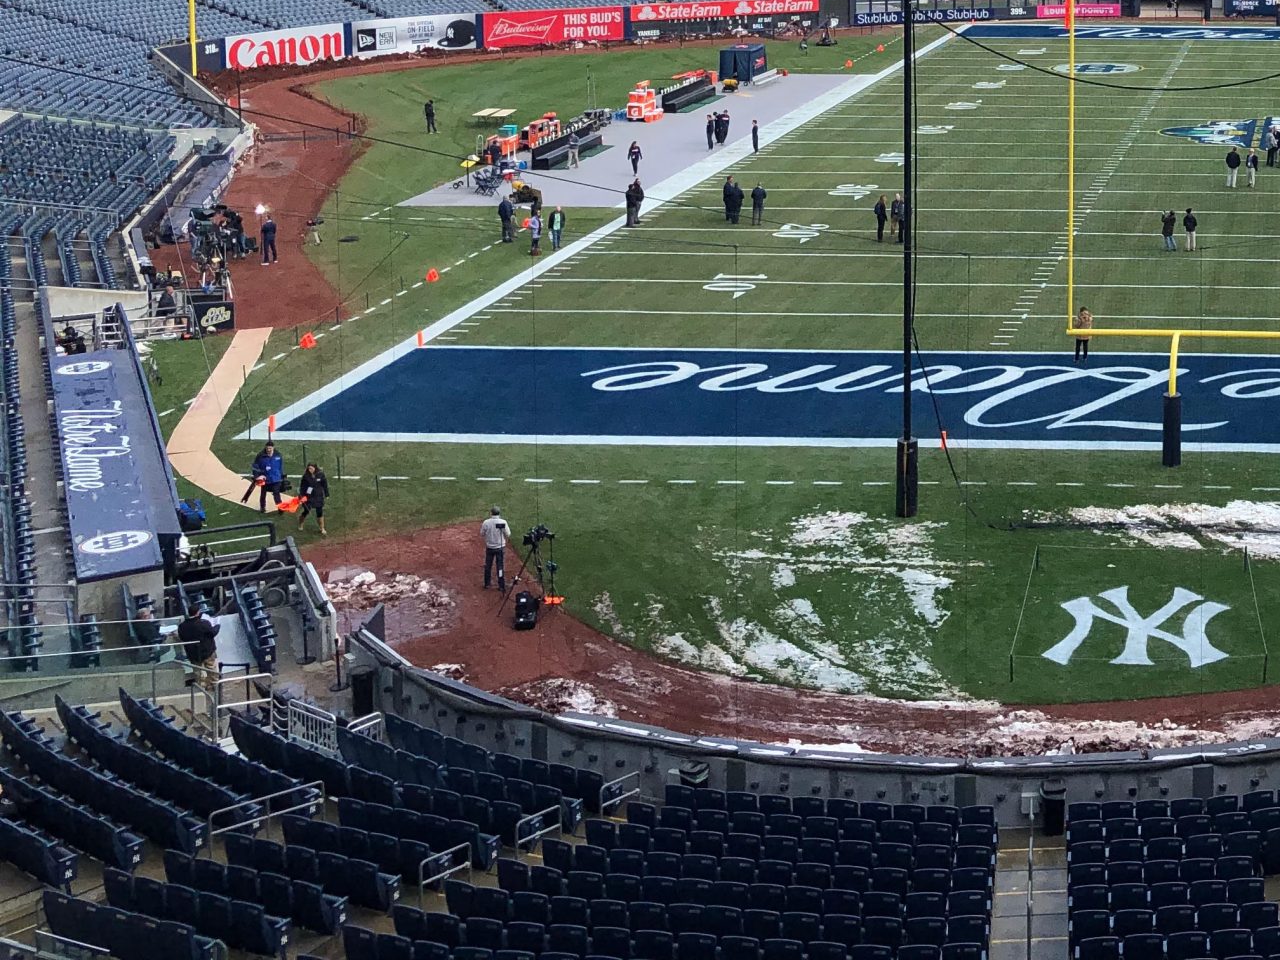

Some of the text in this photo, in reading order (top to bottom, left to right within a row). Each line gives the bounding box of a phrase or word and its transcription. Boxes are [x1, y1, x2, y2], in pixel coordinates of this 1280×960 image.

[858, 9, 989, 24] StubHub StubHub
[1010, 7, 1023, 15] 399
[564, 12, 621, 25] THIS BUD'S
[379, 31, 394, 39] NEW
[494, 22, 550, 35] Budweiser
[564, 25, 611, 38] FOR YOU.
[380, 38, 394, 46] ERA
[229, 32, 342, 71] Canon
[201, 310, 231, 327] CLEAN
[581, 361, 1229, 432] Dame
[61, 400, 132, 492] Notre Dame
[1041, 586, 1231, 668] NY
